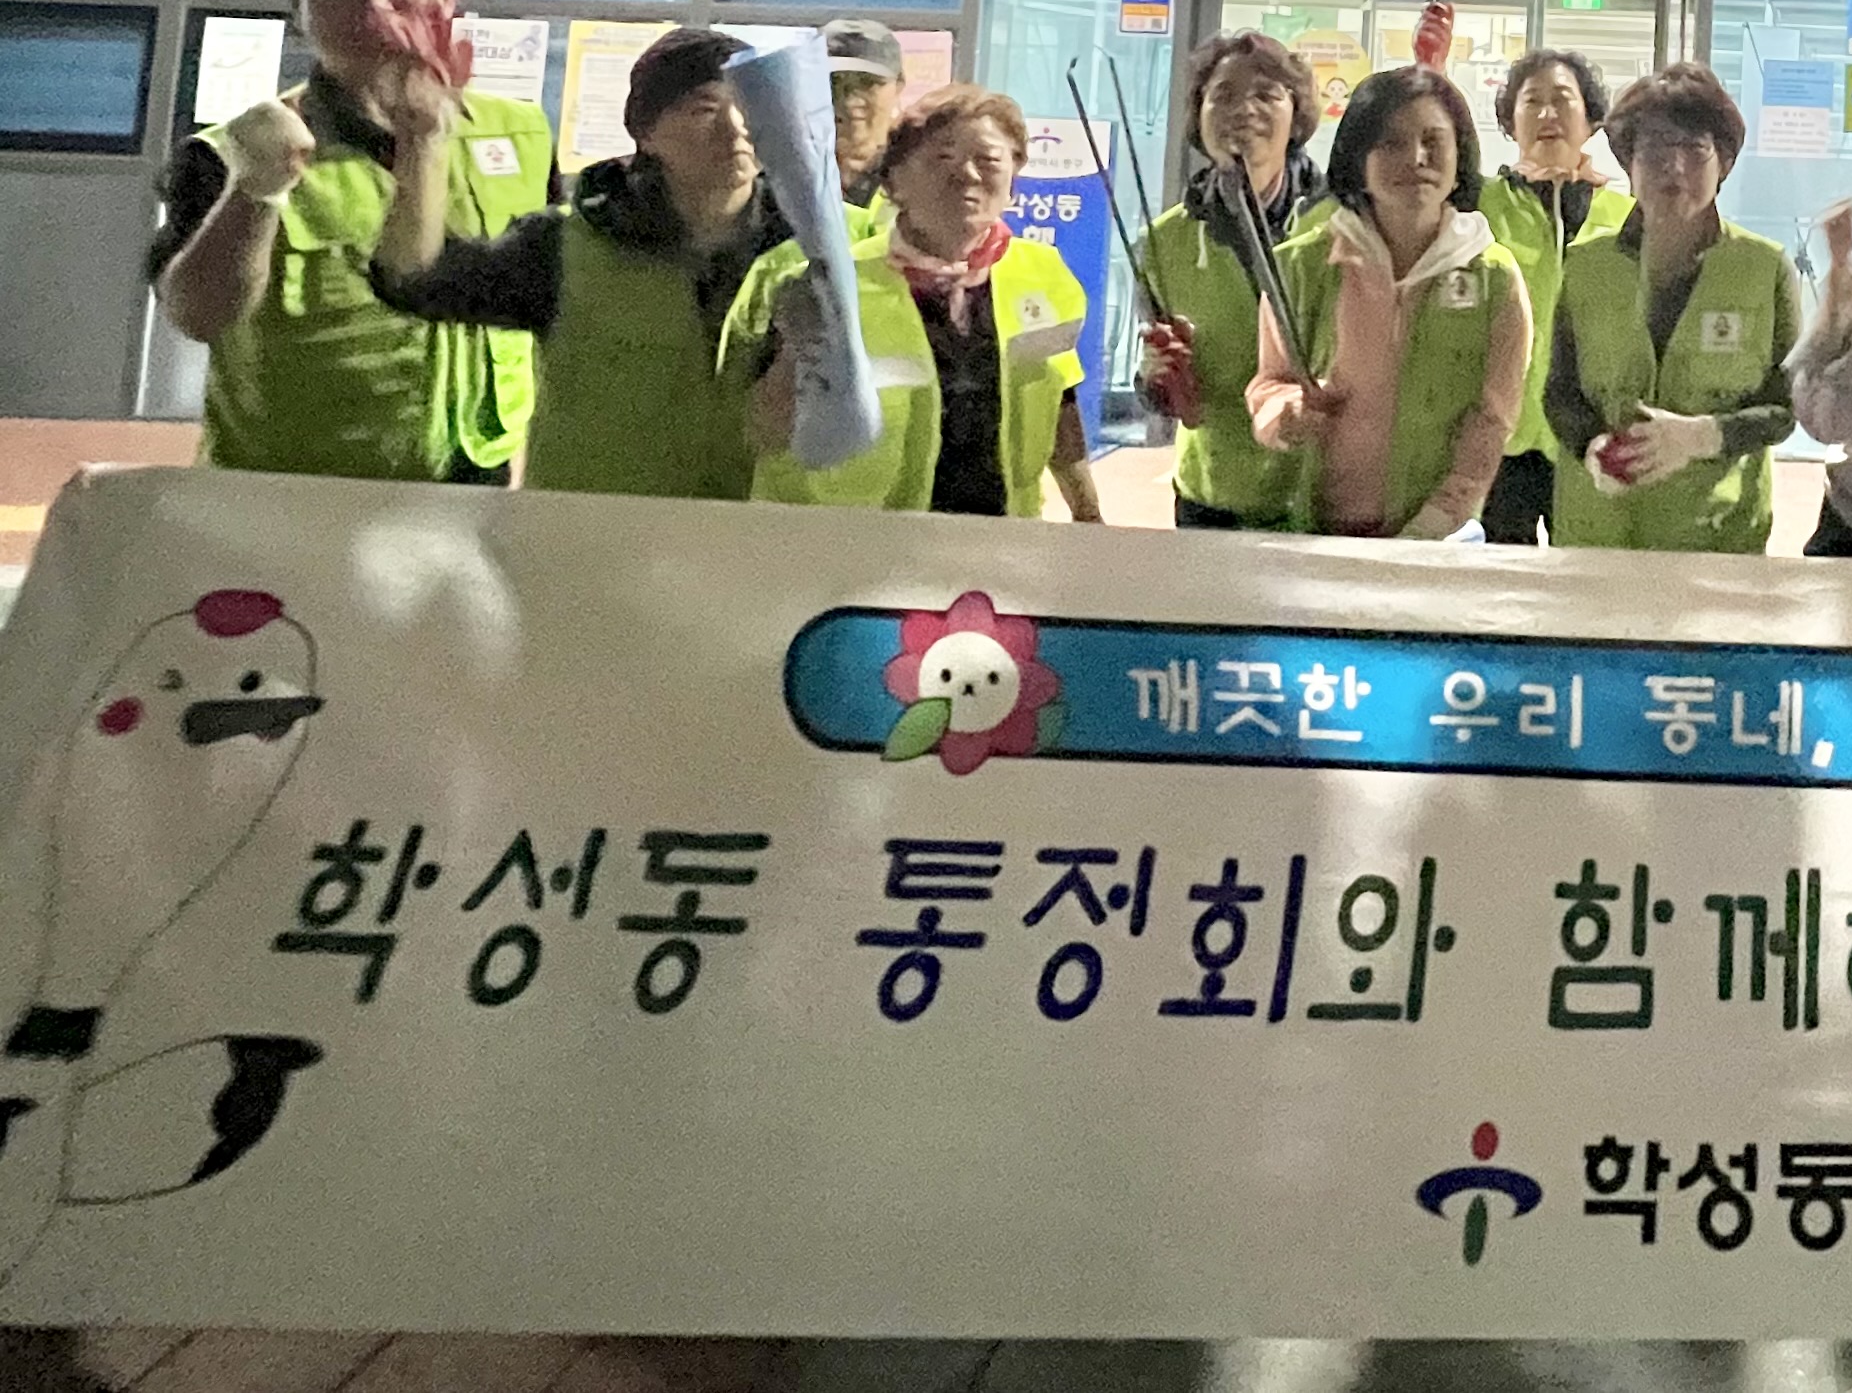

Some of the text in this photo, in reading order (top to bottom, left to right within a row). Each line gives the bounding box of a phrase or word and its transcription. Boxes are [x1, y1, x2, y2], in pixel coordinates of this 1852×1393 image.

[1129, 660, 1371, 742] 깨끗한
[1430, 670, 1582, 749] 우리
[1644, 675, 1834, 768] 동네,
[271, 818, 772, 1014] 학성동
[855, 837, 1458, 1022] 통정회와
